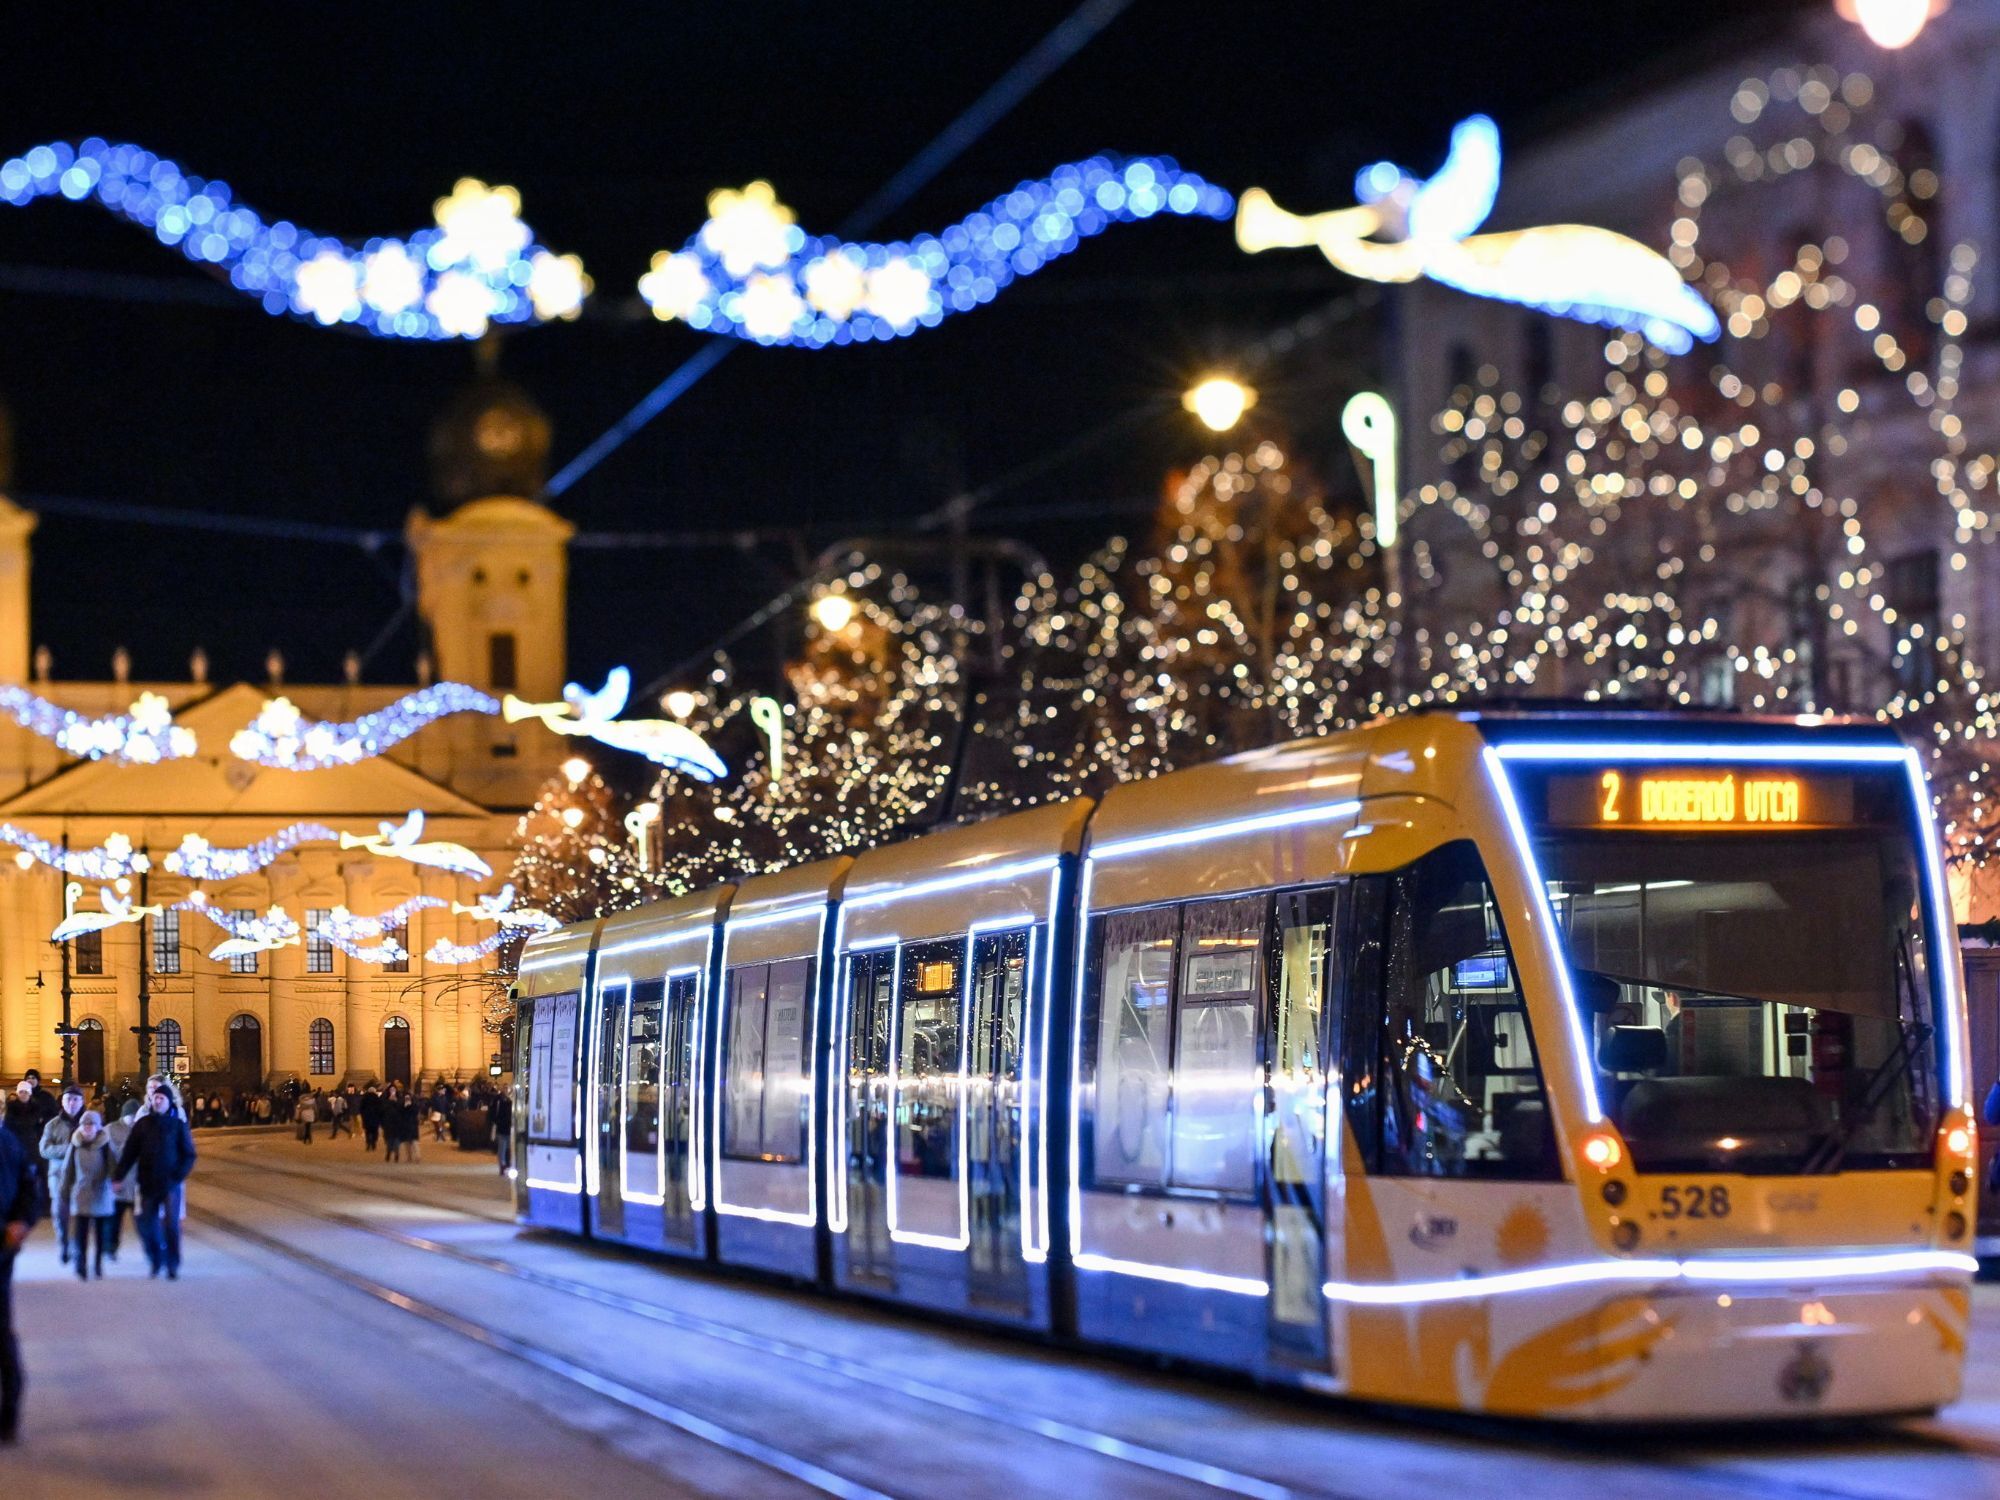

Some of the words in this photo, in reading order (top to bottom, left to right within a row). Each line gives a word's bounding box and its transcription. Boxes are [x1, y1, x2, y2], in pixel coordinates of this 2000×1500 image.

[1602, 773, 1620, 821] 2
[1743, 781, 1799, 822] UTCA
[1660, 1184, 1731, 1219] 528
